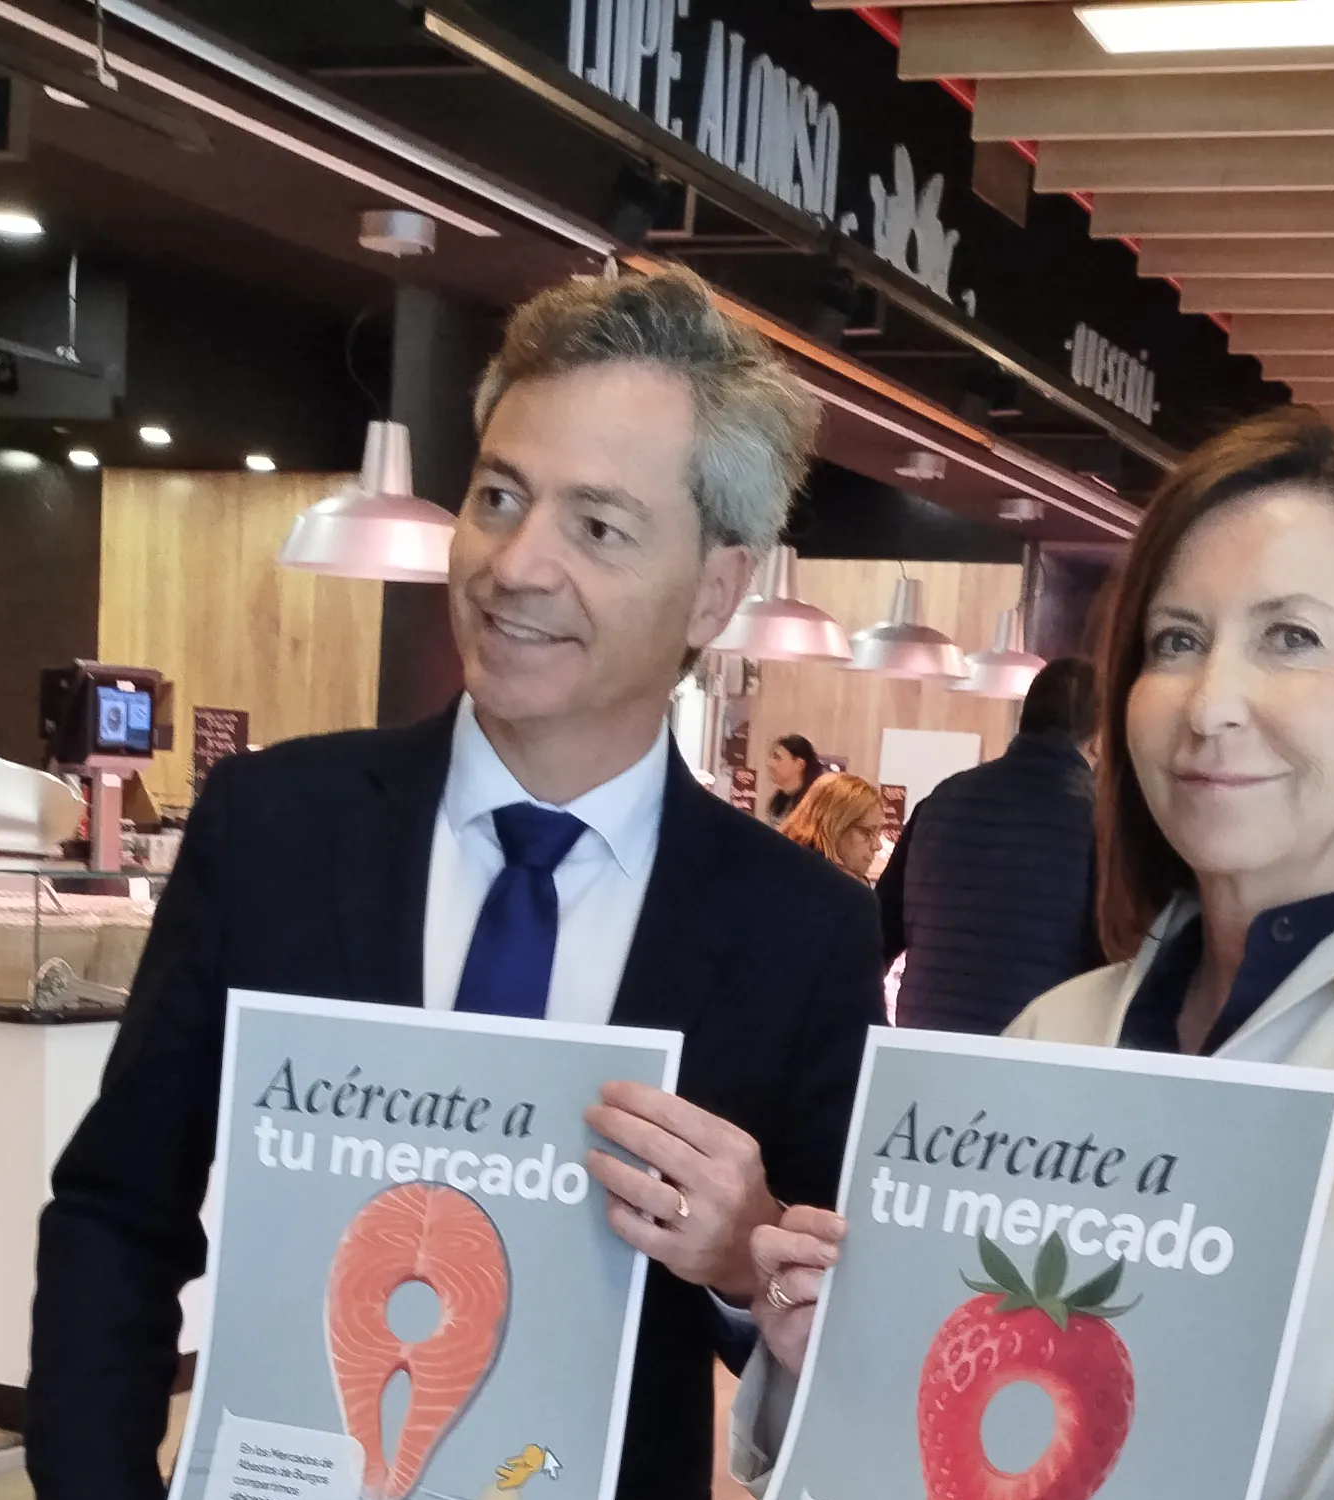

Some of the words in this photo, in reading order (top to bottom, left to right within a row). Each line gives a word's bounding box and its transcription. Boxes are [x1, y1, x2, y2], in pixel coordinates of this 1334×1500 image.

[696, 19, 840, 223] ALONSO
[253, 1056, 492, 1134] Acércate
[501, 1100, 537, 1138] a
[253, 1115, 315, 1172] tu
[328, 1143, 590, 1204] mercado
[874, 1100, 1126, 1189] Acércate
[1135, 1152, 1179, 1196] a
[870, 1166, 931, 1229] tu
[942, 1202, 1234, 1276] mercado
